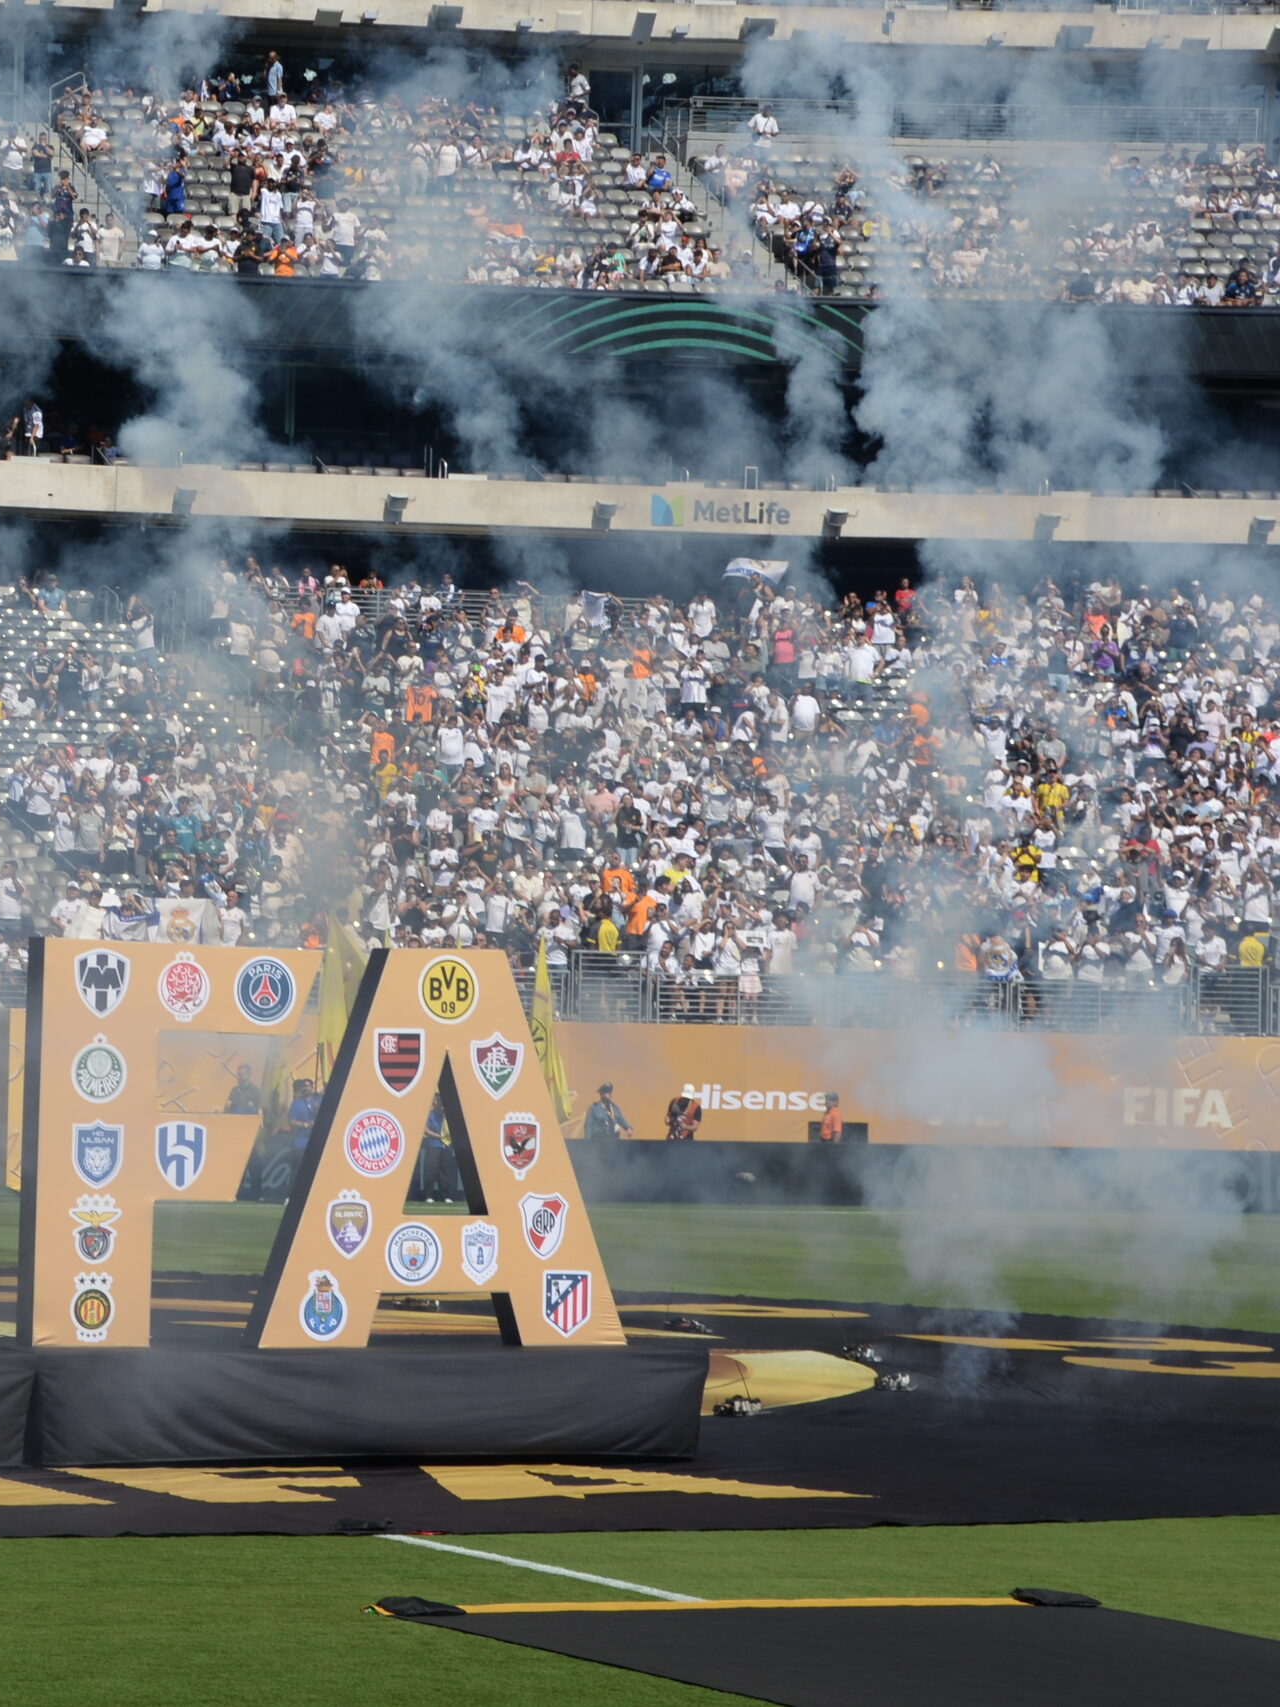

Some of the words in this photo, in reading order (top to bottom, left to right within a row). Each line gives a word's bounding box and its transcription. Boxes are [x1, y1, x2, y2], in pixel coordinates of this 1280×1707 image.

[693, 500, 790, 525] MetLife
[248, 964, 283, 980] PARIS
[430, 966, 469, 1001] BVB
[441, 1002, 456, 1014] 09
[78, 1069, 121, 1098] PALMEIRAS
[1122, 1086, 1233, 1129] FIFA
[352, 1125, 363, 1138] FC
[363, 1115, 398, 1139] BAYERN
[81, 1136, 115, 1144] ULSAN
[394, 1230, 434, 1247] MANCHESTER
